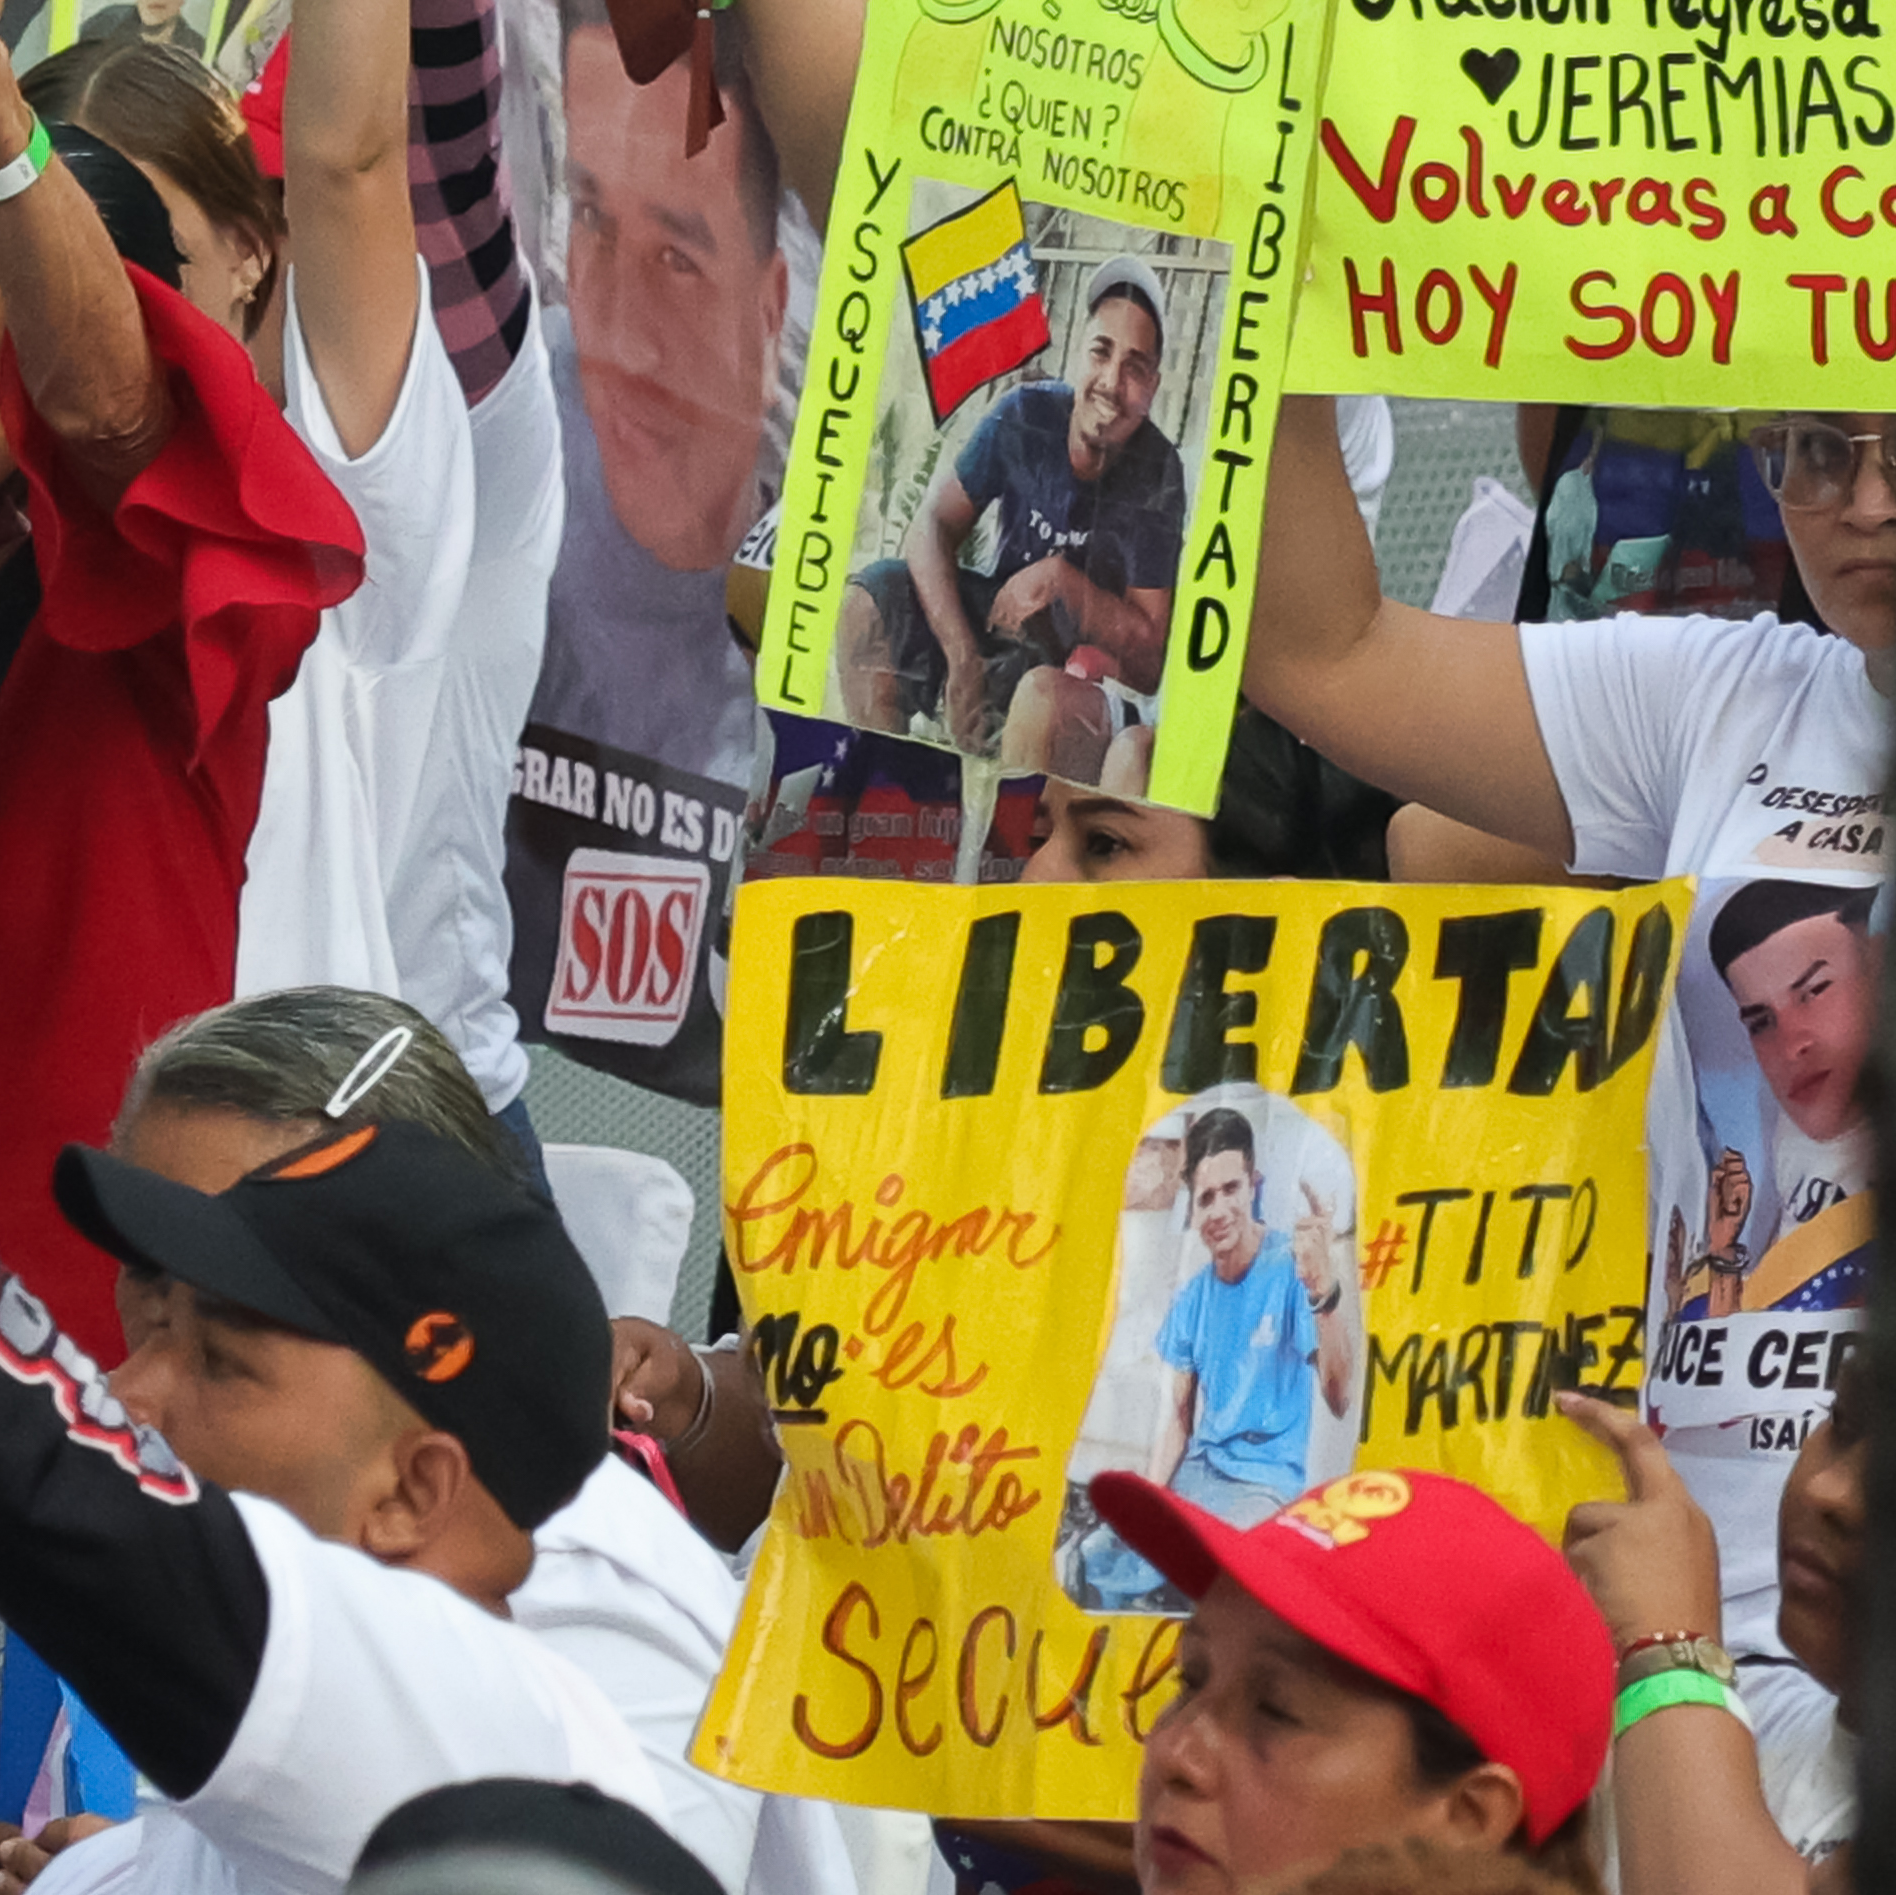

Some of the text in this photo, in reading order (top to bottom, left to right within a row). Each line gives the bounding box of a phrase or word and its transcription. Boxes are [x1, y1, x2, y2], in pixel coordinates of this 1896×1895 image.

[988, 14, 1146, 92] NOSOTROS
[1507, 52, 1896, 158] JEREMIAS
[918, 104, 1189, 224] CONTRA NOSOTROS
[1319, 114, 1729, 242] Volveras
[1748, 182, 1799, 240] a
[1343, 254, 1519, 370] HOY
[1563, 268, 1741, 366] SOY
[601, 771, 656, 838] NO
[658, 788, 705, 854] ES
[1773, 818, 1801, 846] A
[561, 885, 694, 1006] SOS
[781, 904, 1675, 1100] LIBERTAD
[1358, 1182, 1596, 1296] #TITO
[869, 1312, 990, 1399] es
[1357, 1304, 1643, 1446] MARTINEZ
